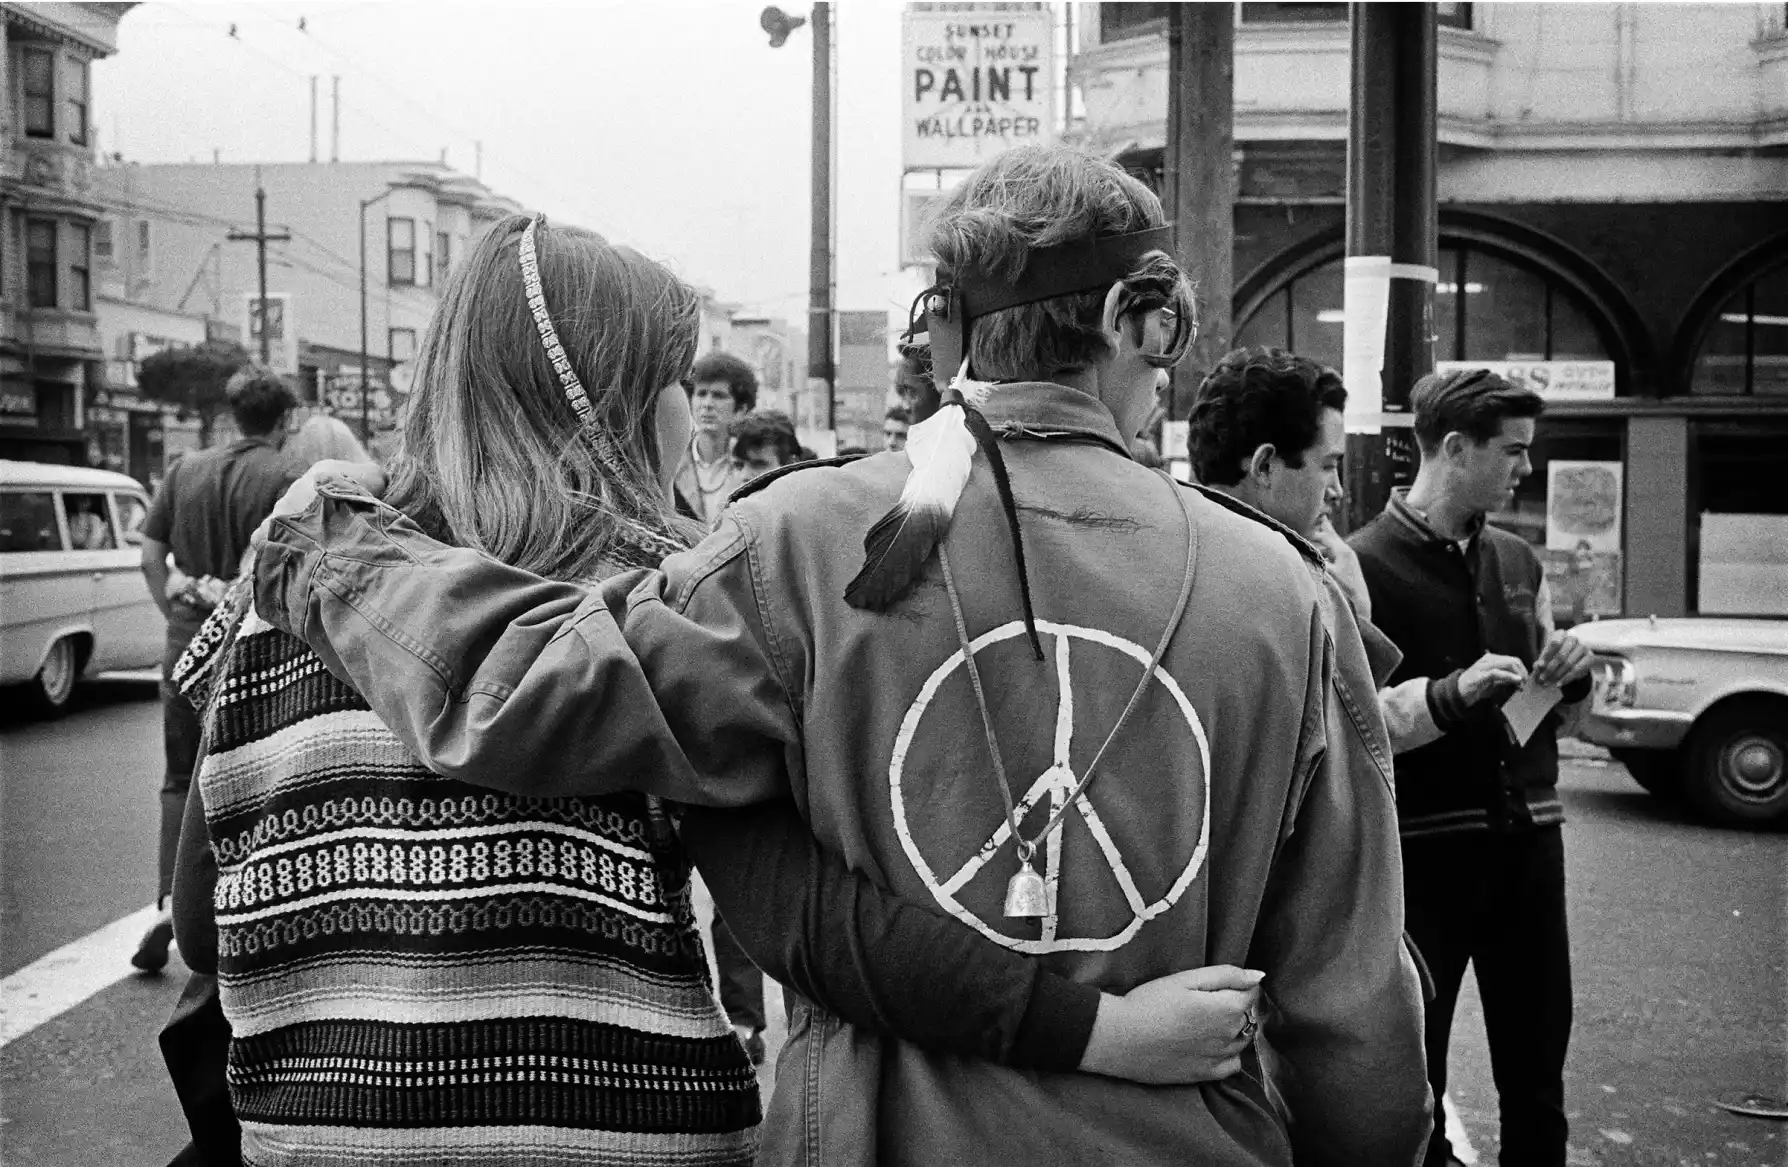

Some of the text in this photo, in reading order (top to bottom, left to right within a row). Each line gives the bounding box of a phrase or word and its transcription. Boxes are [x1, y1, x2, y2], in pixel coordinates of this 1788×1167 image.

[946, 24, 1013, 38] SUNSET
[915, 66, 1038, 101] PAINT
[917, 117, 1039, 137] WALLPAPER
